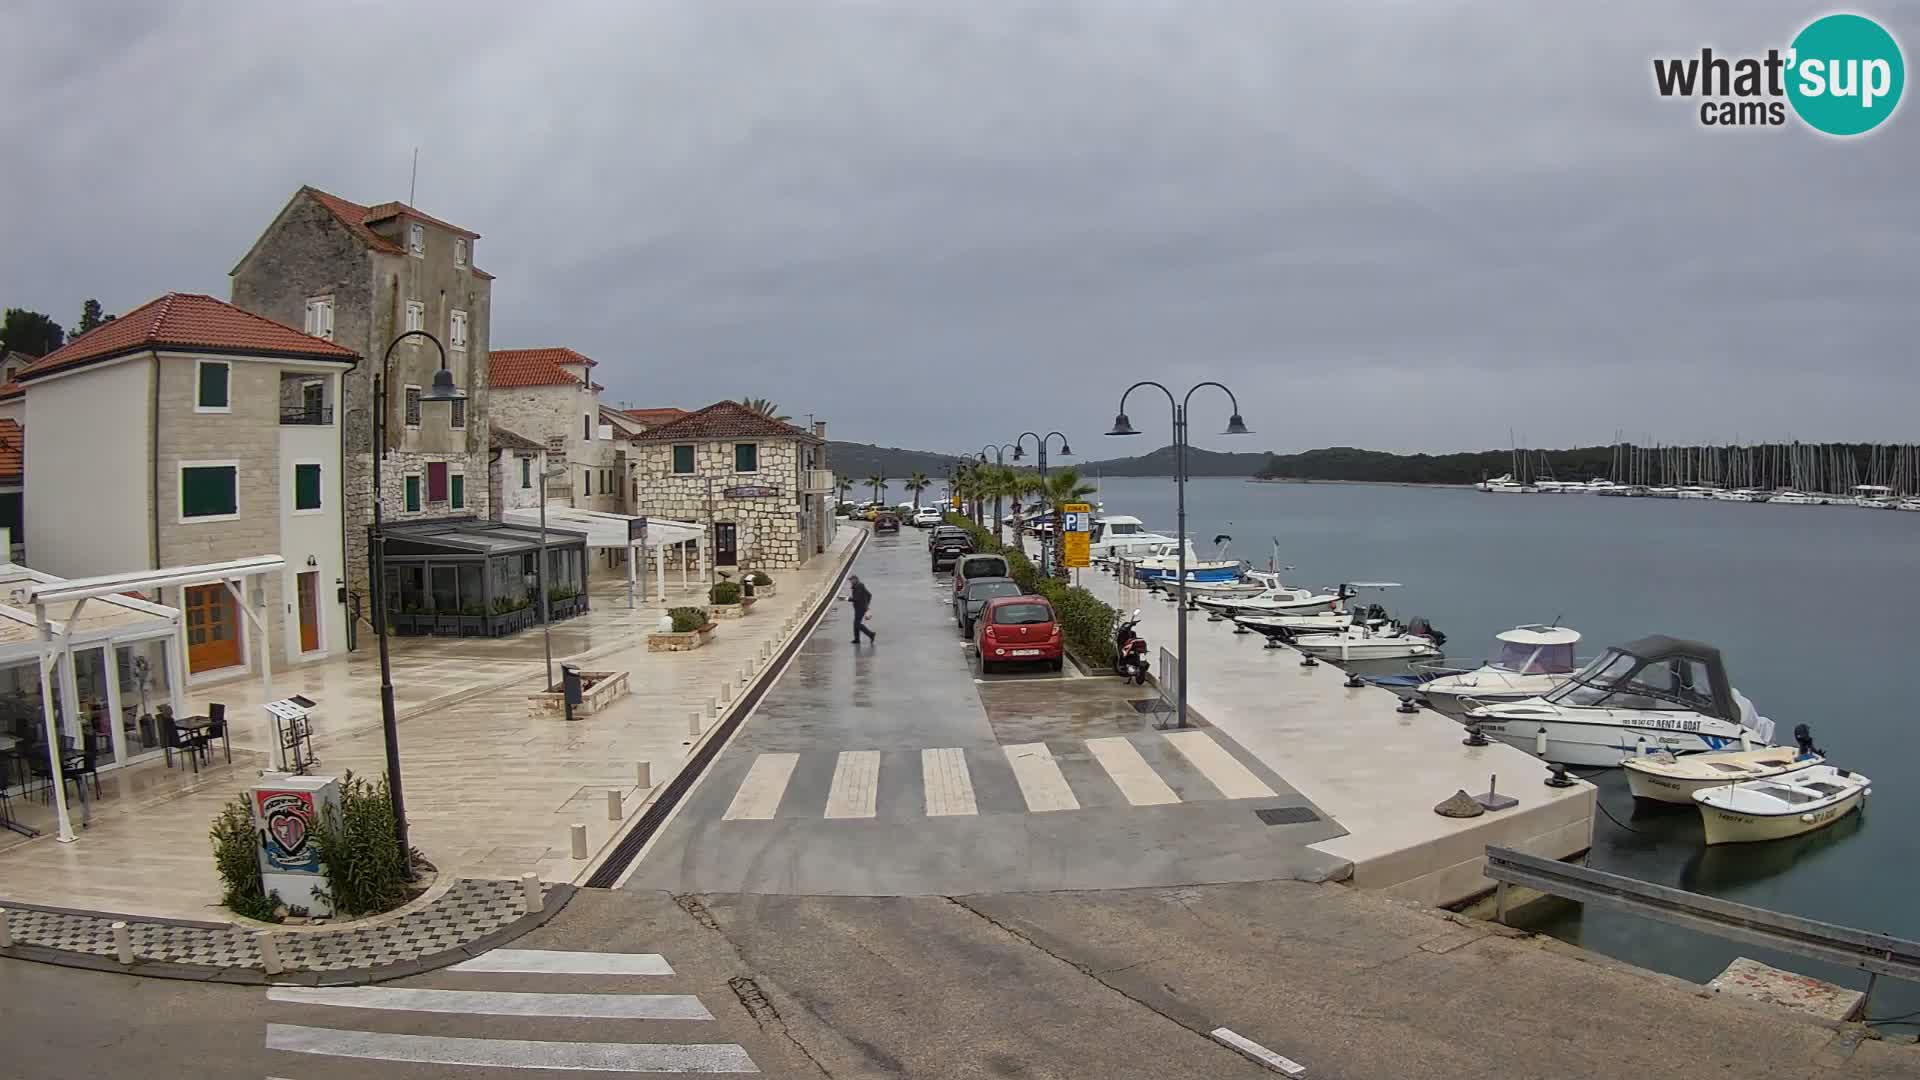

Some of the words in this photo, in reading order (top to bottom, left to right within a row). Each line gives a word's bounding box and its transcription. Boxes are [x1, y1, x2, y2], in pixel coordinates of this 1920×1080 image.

[1066, 514, 1077, 530] P
[1656, 720, 1676, 728] RENT
[1676, 720, 1682, 728] A
[1683, 720, 1701, 731] BOAT
